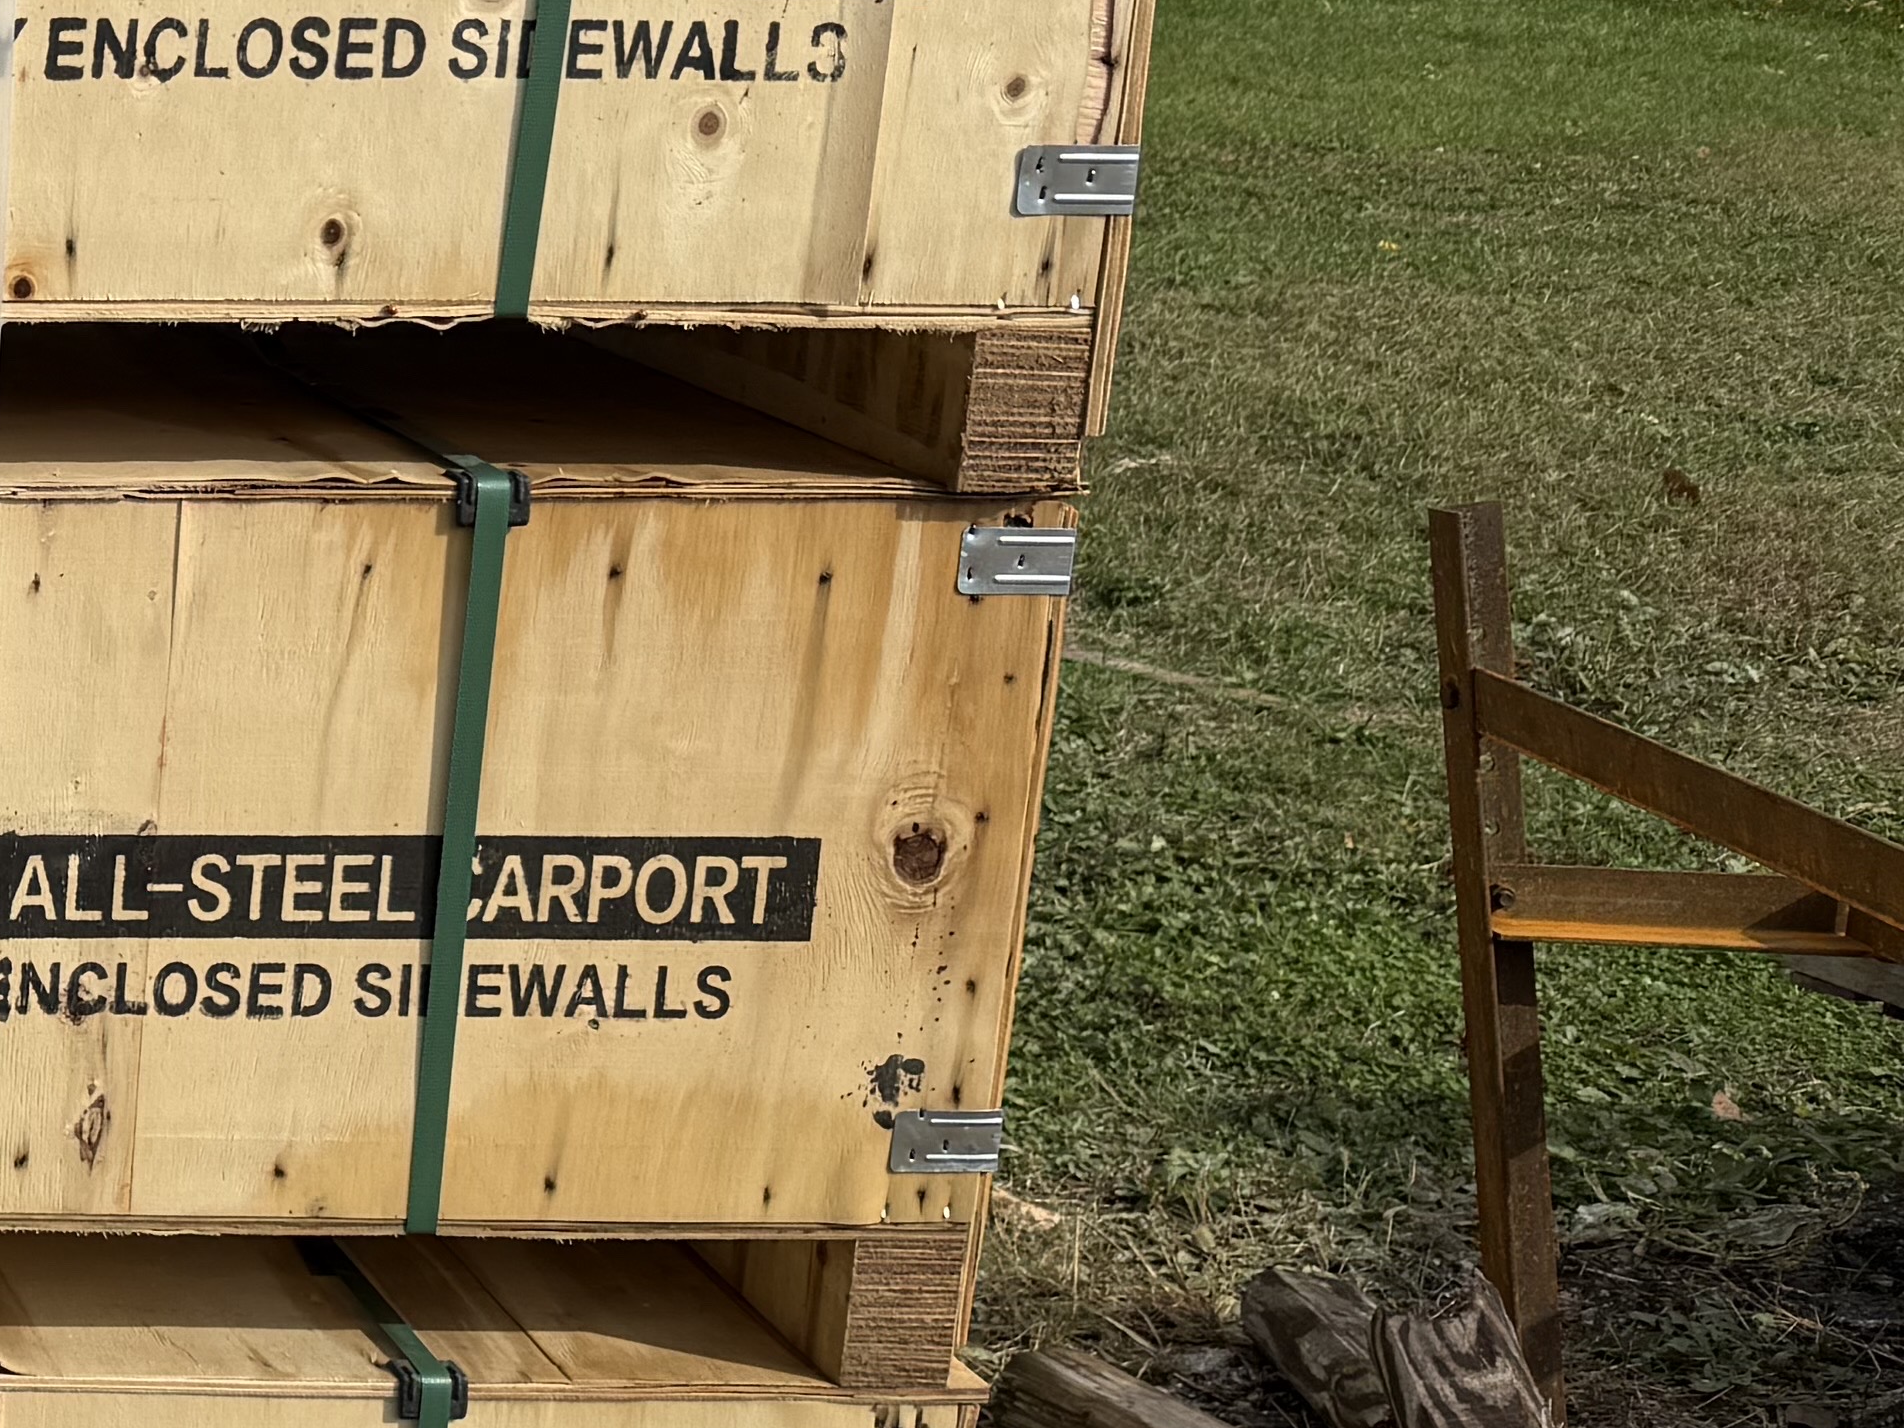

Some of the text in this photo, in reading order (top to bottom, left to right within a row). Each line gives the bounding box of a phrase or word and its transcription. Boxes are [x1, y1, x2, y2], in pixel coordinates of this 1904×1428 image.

[44, 16, 428, 82] ENCLOSED
[8, 854, 416, 922] ALL-STEEL
[466, 853, 788, 926] ARPORT
[353, 963, 733, 1019] SIEWALLS
